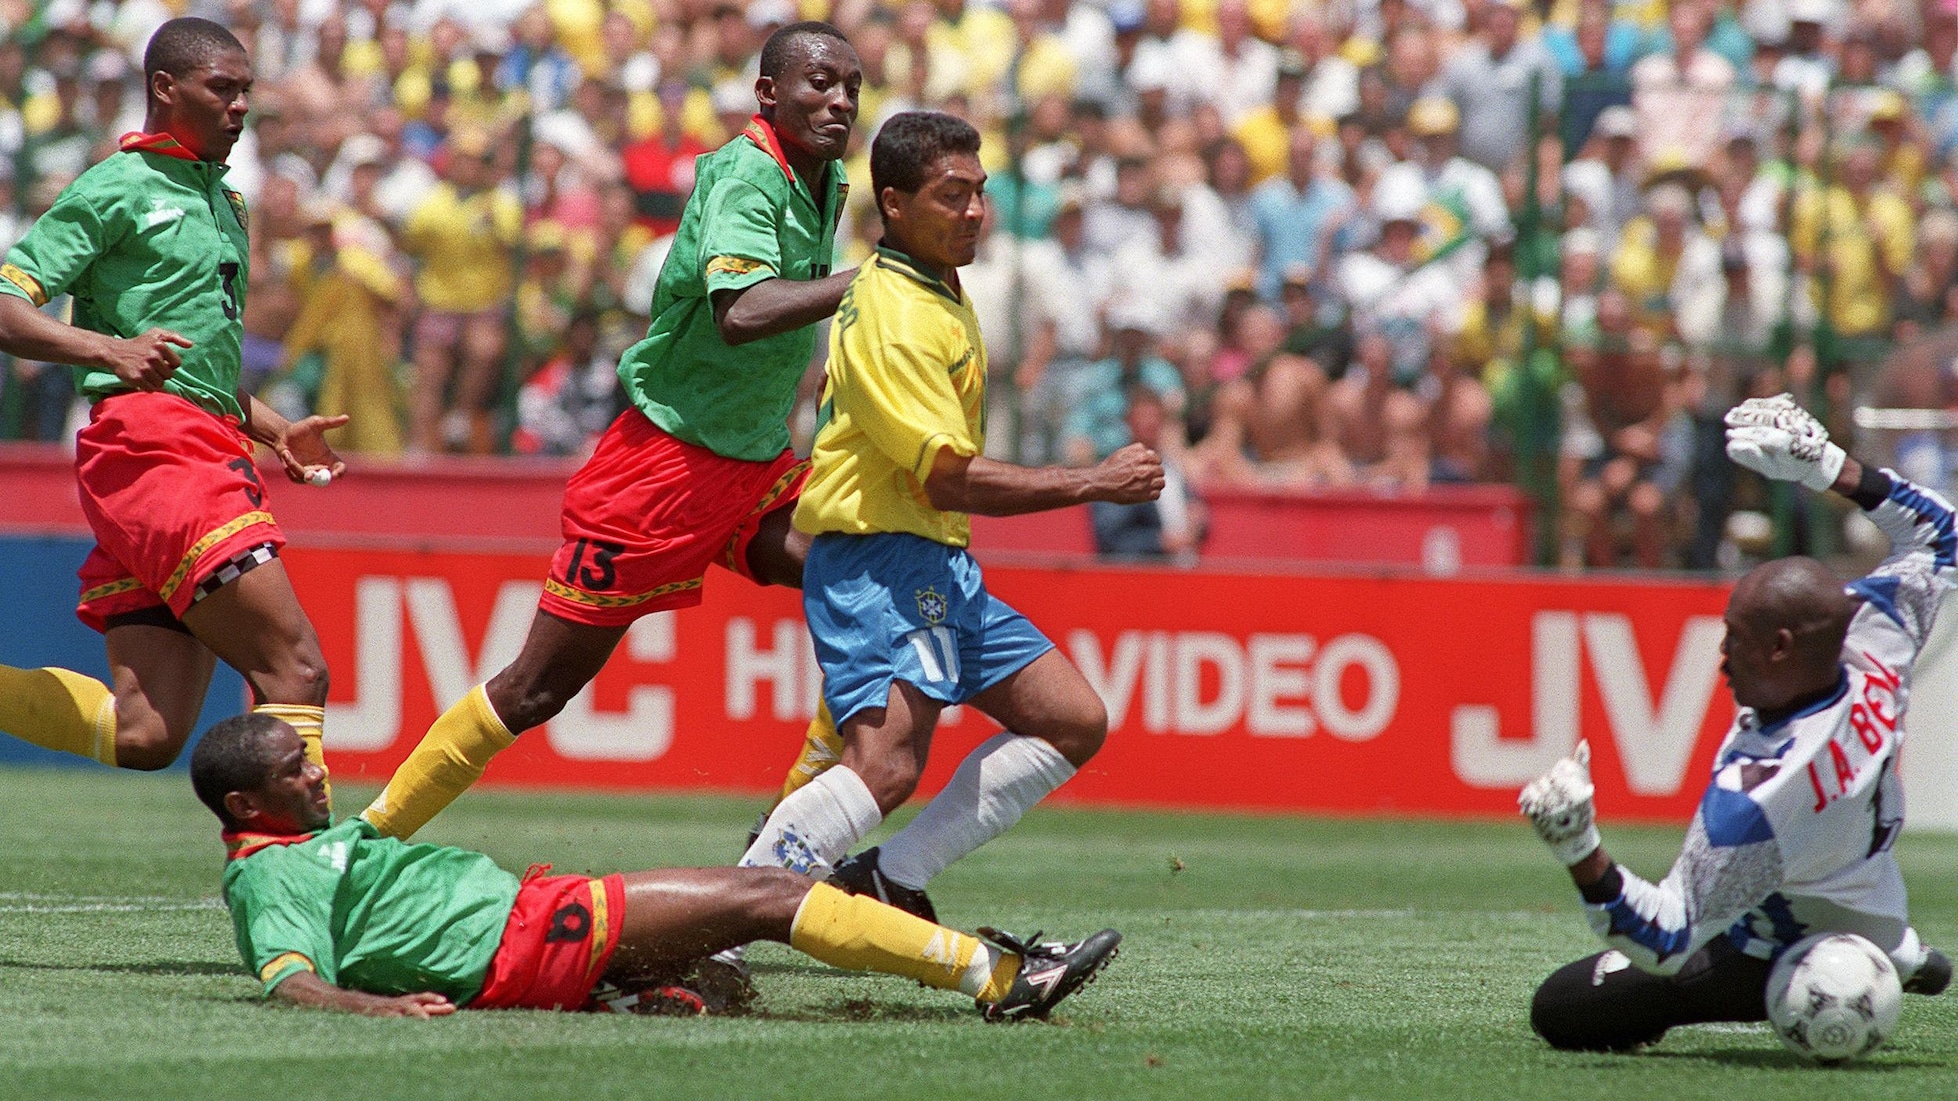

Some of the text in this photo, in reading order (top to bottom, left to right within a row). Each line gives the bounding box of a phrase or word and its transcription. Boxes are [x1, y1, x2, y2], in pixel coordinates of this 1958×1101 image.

[219, 262, 239, 321] 3
[227, 456, 263, 509] 3
[565, 537, 626, 592] 13
[906, 626, 959, 683] 11
[1066, 626, 1401, 744] VIDEO
[1449, 609, 1729, 797] JV
[1850, 651, 1901, 756] BEL
